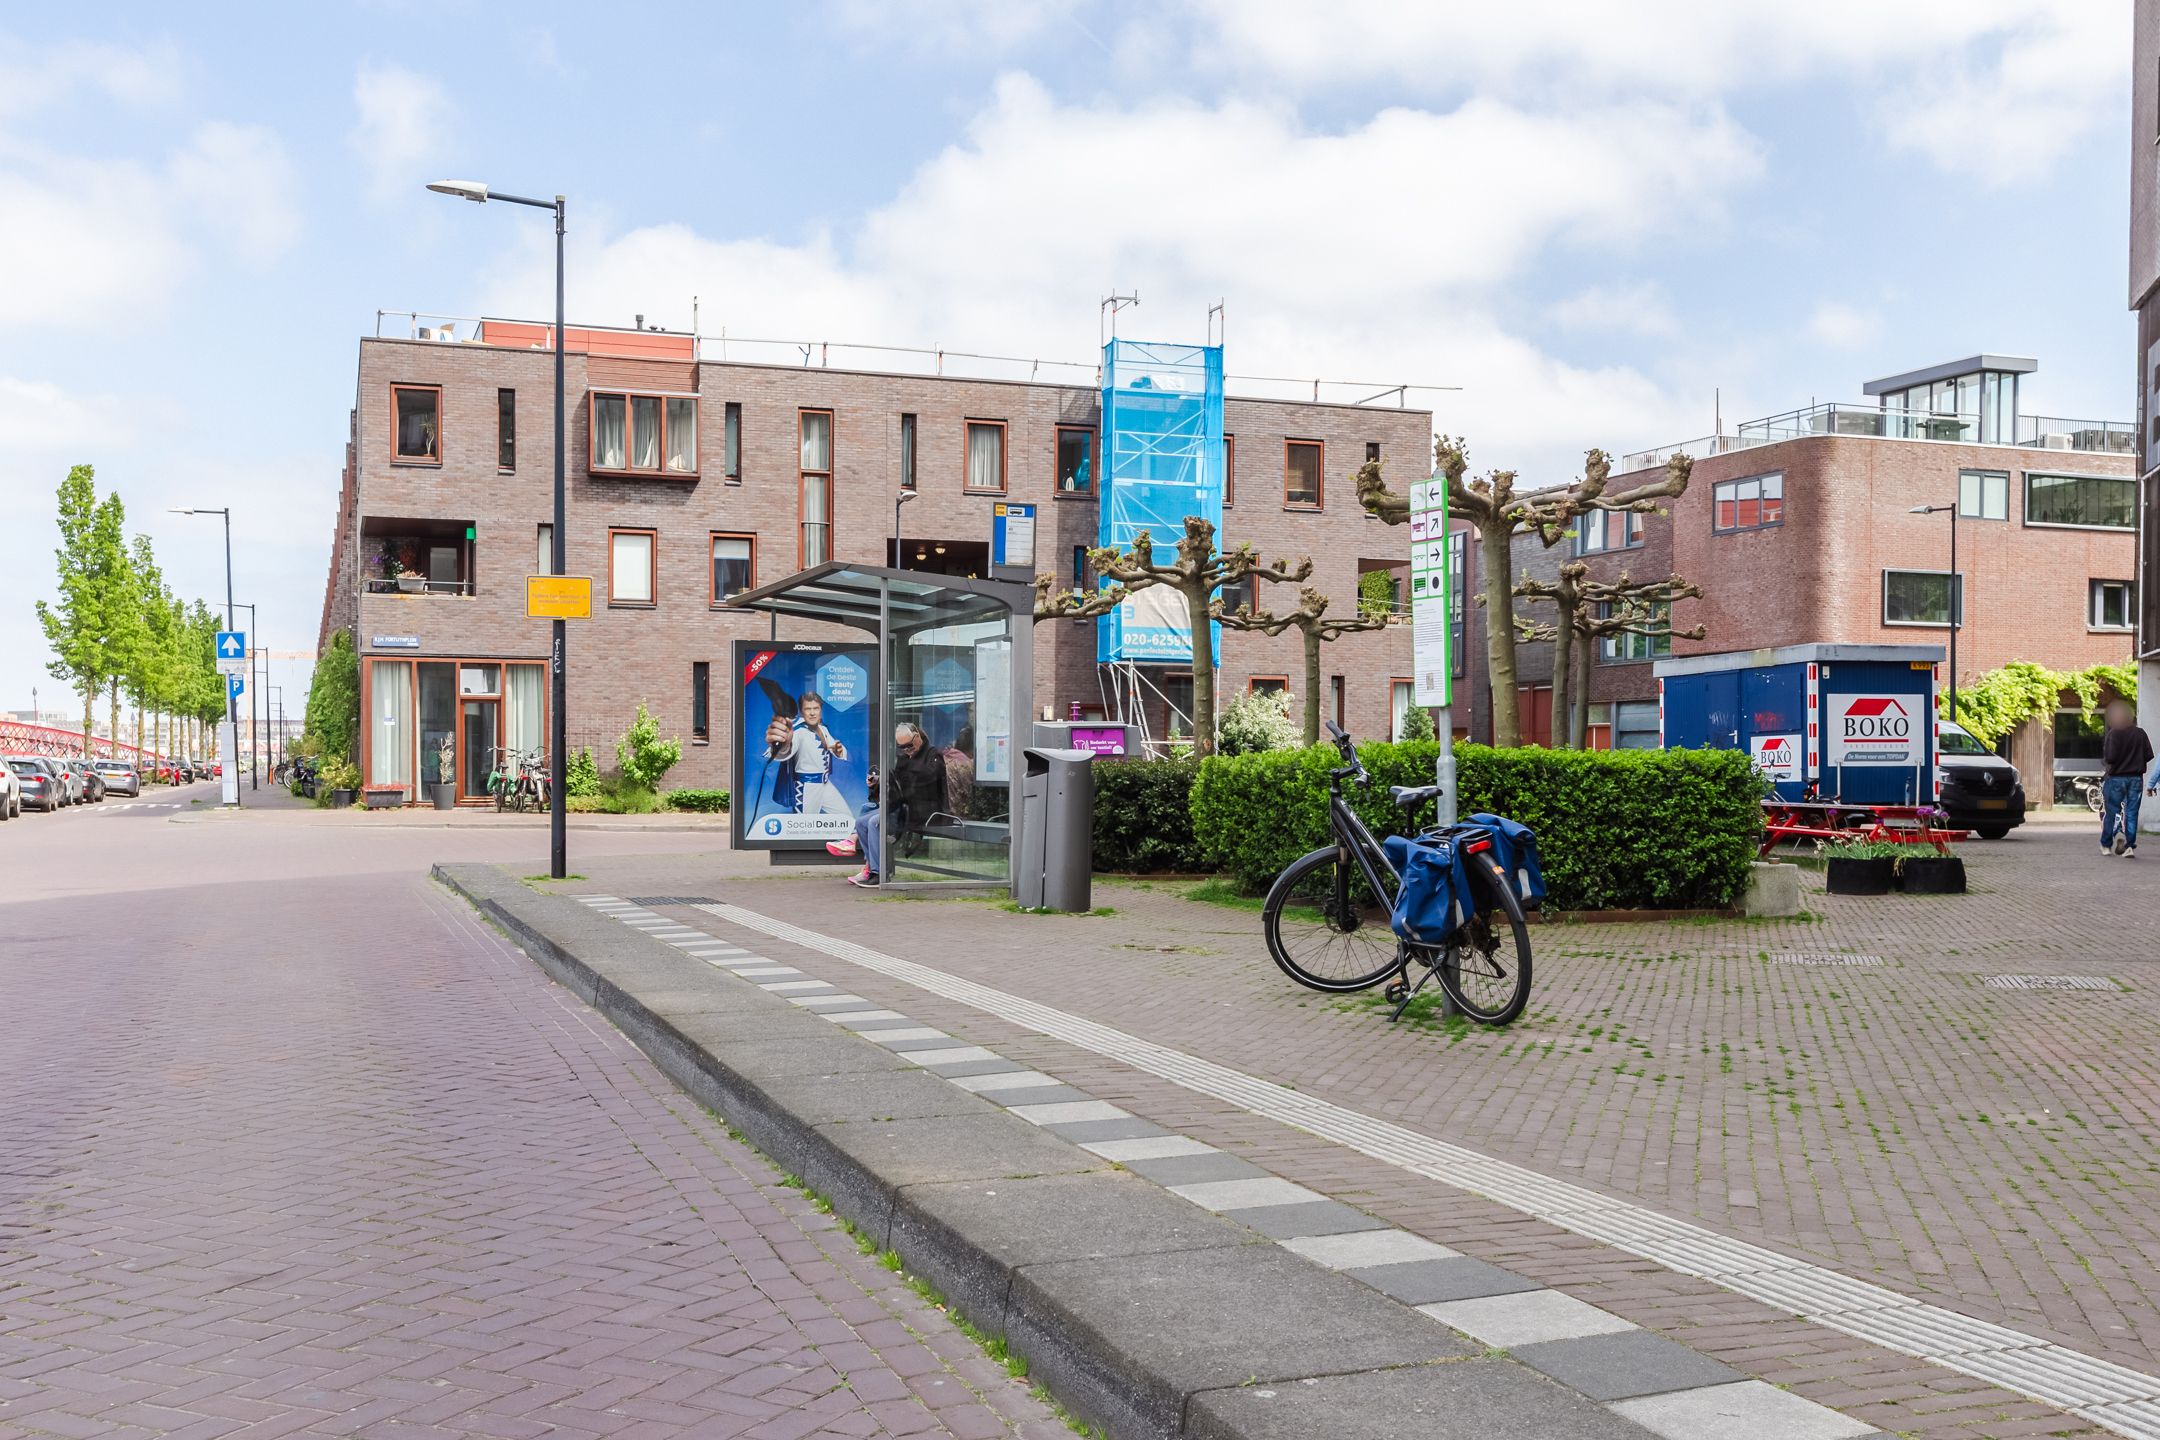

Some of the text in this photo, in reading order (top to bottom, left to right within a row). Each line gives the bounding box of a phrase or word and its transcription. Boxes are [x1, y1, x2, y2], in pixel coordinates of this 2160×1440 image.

[751, 653, 769, 673] -50%
[1843, 717, 1909, 737] BOKO
[1760, 750, 1792, 764] BOKO
